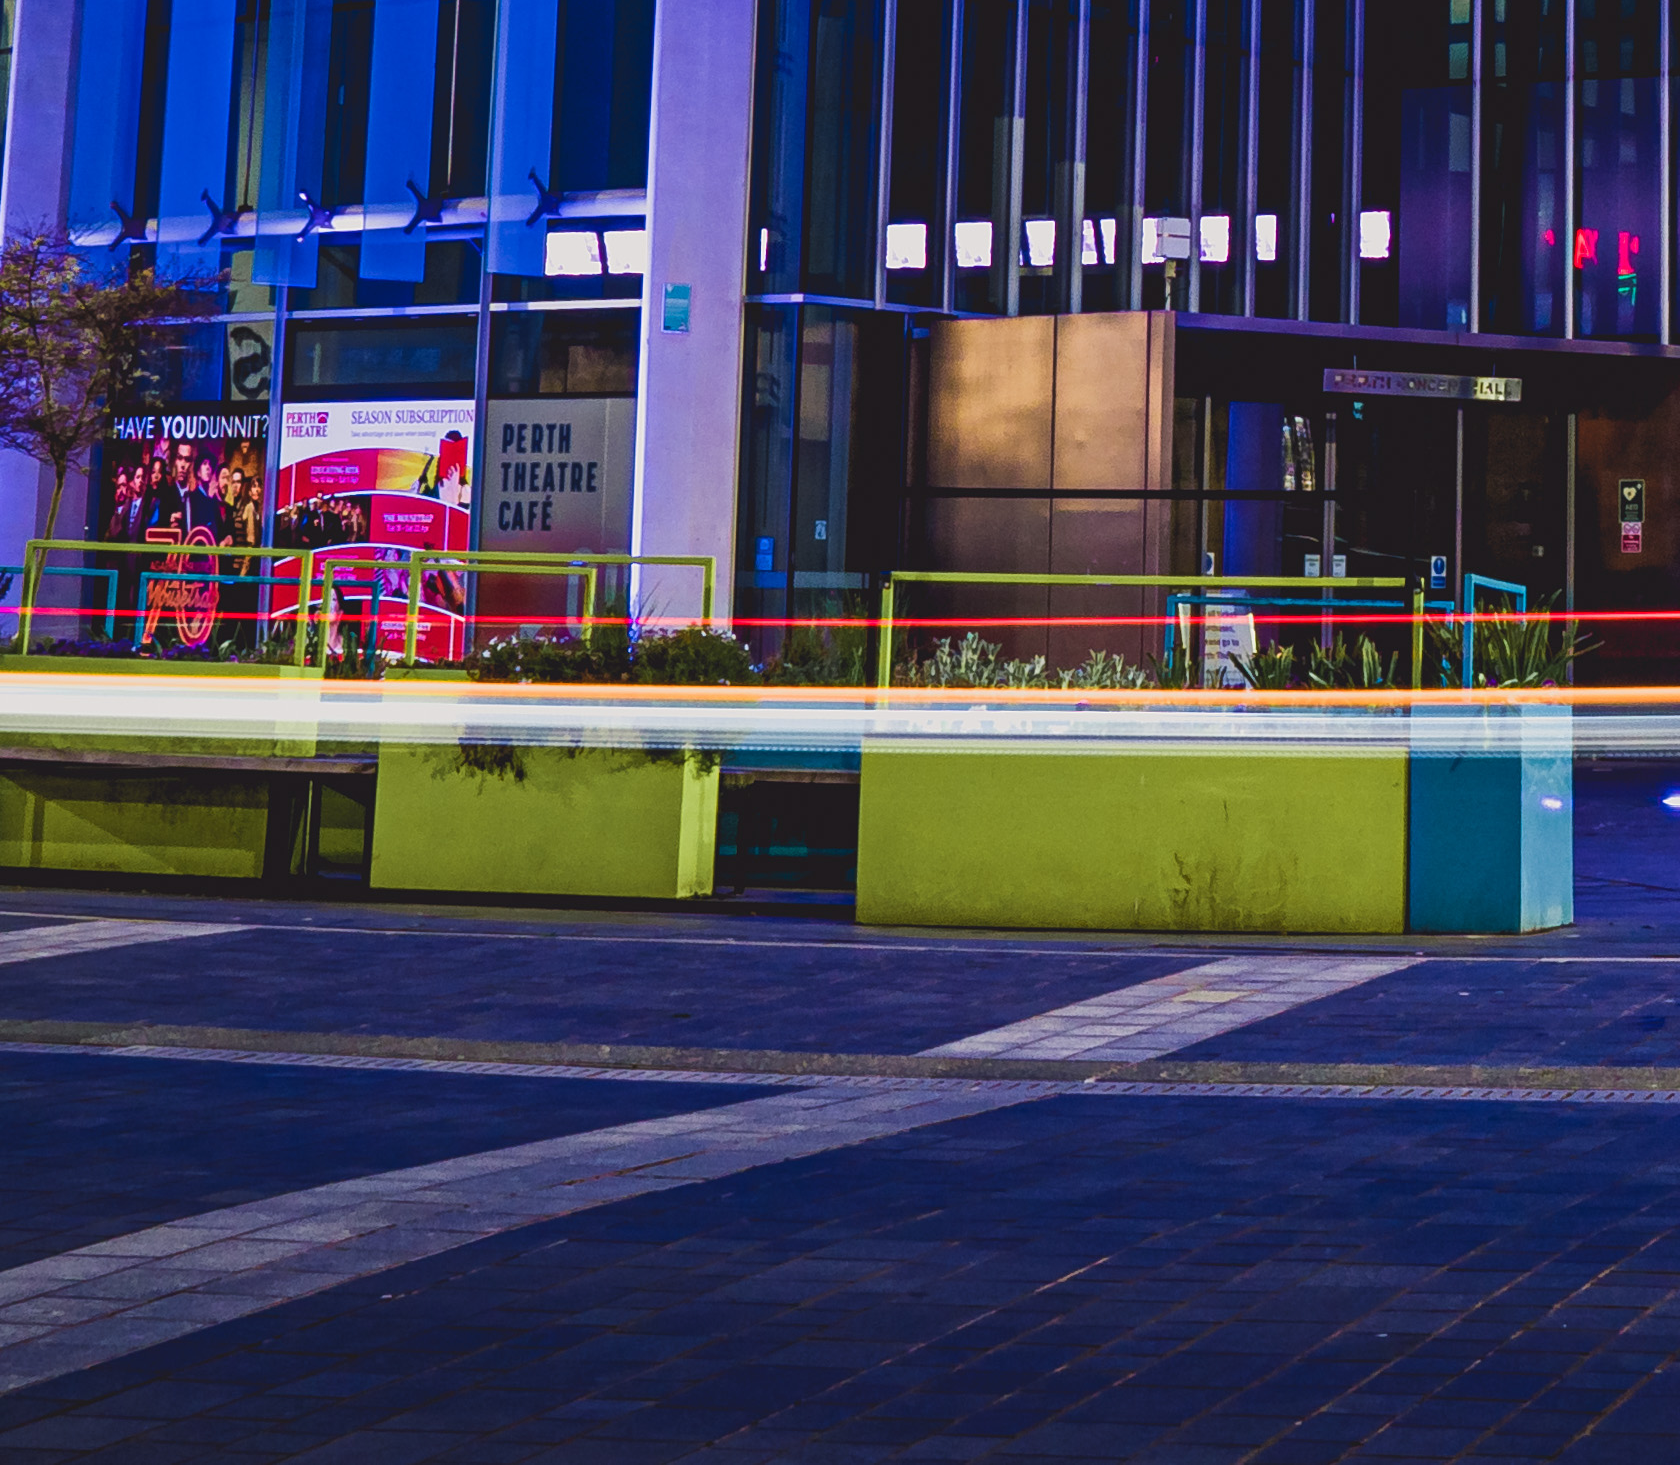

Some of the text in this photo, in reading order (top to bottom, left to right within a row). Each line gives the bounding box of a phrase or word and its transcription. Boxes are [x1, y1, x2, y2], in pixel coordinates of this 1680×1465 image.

[1396, 376, 1469, 393] CONCER
[286, 412, 317, 425] PERTH
[351, 409, 475, 425] SEASON SUBSCRIPTION
[113, 416, 156, 439] HAVE
[286, 425, 329, 438] THEATRE
[502, 423, 572, 453] PERTH
[501, 462, 598, 492] THEATRE
[499, 494, 553, 531] CAFÉ
